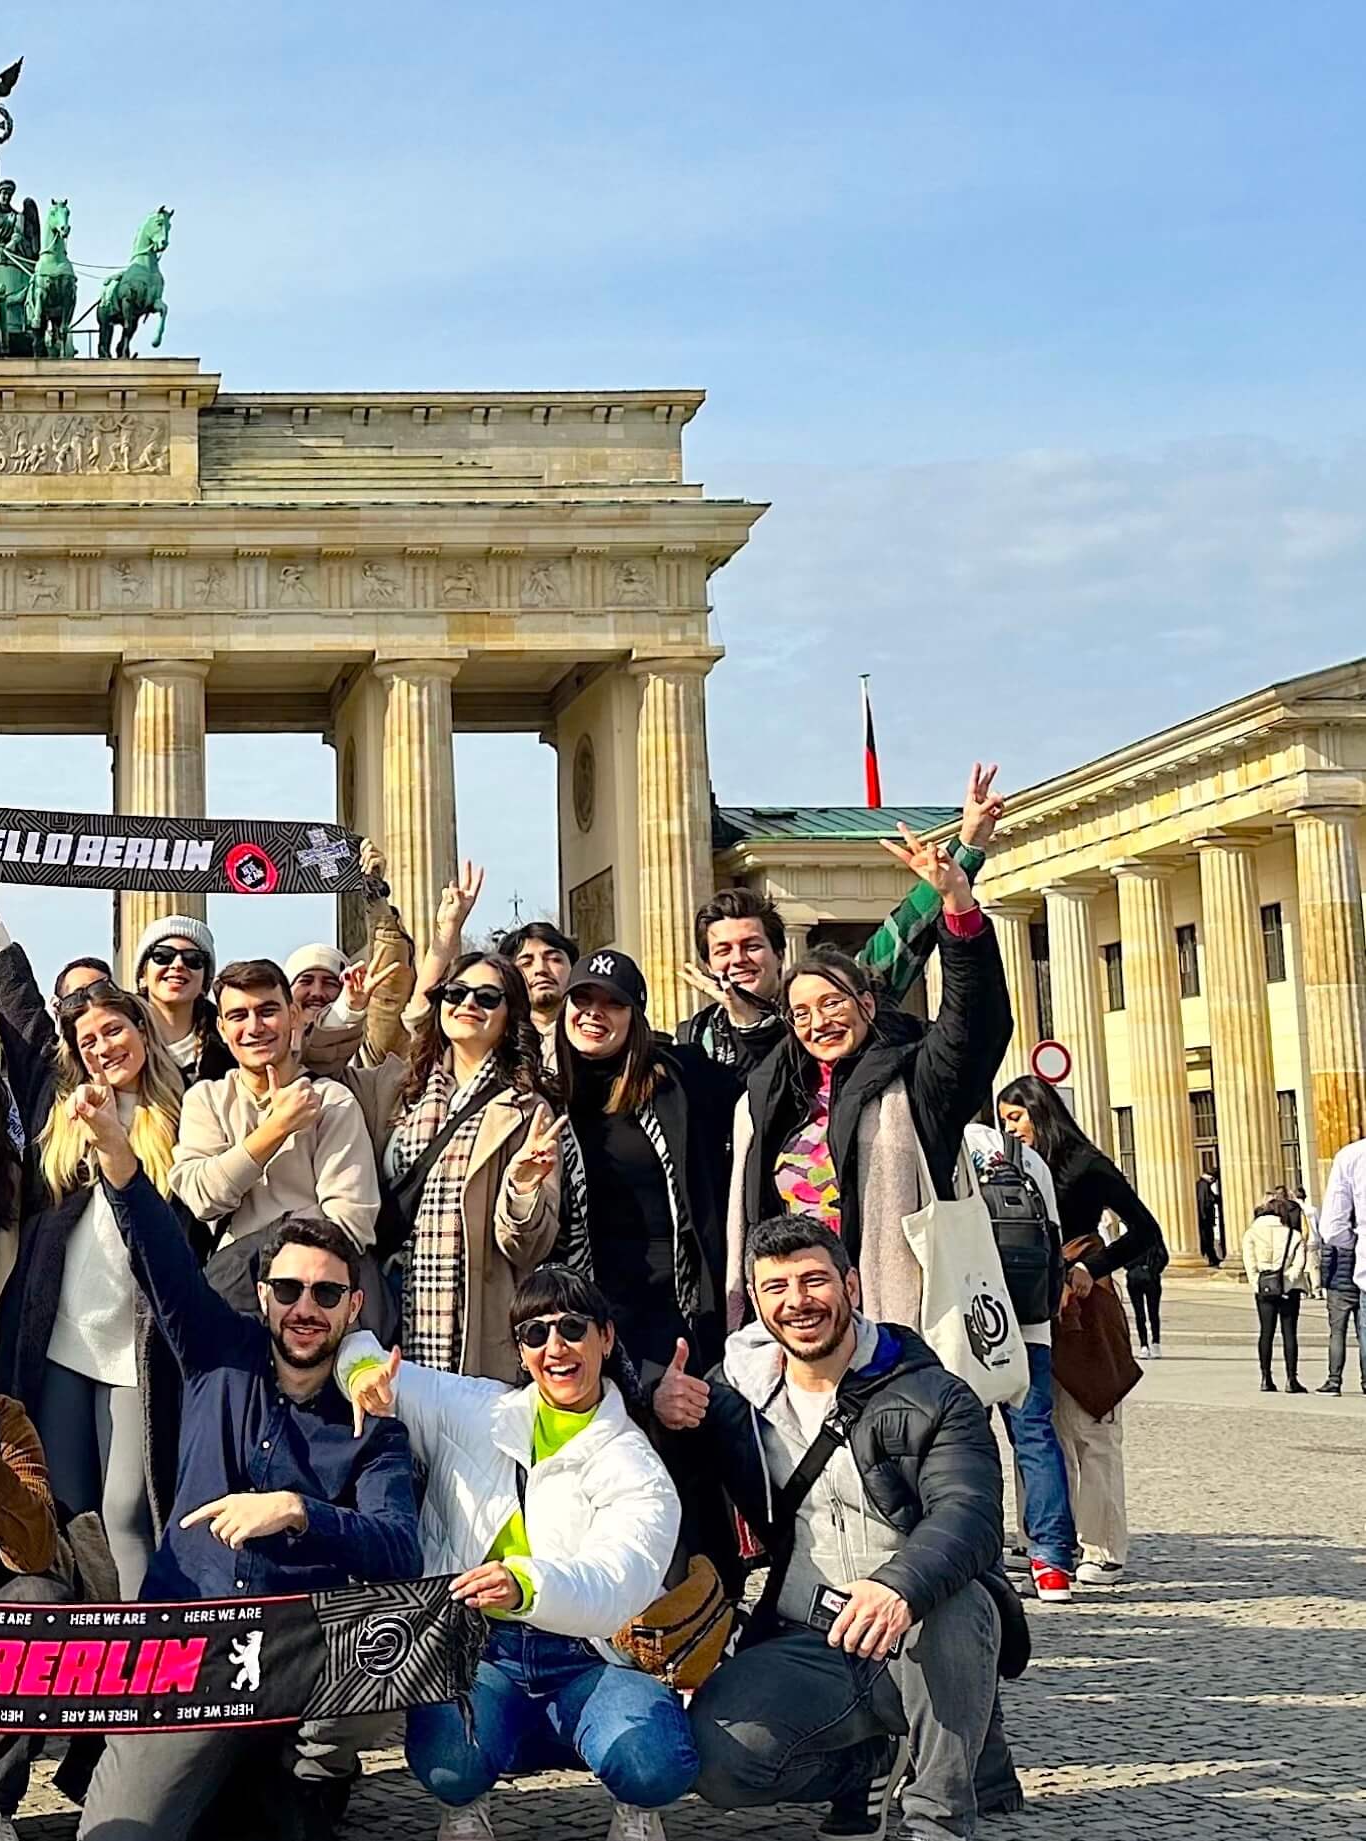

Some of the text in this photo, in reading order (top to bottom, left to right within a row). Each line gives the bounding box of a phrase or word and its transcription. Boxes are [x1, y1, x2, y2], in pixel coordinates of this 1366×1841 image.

[72, 834, 216, 873] BERLIN
[588, 954, 616, 976] NY
[6, 1612, 32, 1626] ARE
[69, 1612, 101, 1626] HERE
[102, 1612, 121, 1626] WE
[122, 1612, 147, 1625] ARE
[183, 1609, 216, 1623] HERE
[217, 1608, 236, 1621] WE
[237, 1607, 262, 1620] ARE
[61, 1710, 86, 1723] ARE
[87, 1709, 106, 1722] WE
[107, 1709, 139, 1722] HERE
[176, 1706, 202, 1720] ARE
[203, 1705, 222, 1718] WE
[223, 1703, 254, 1717] HERE
